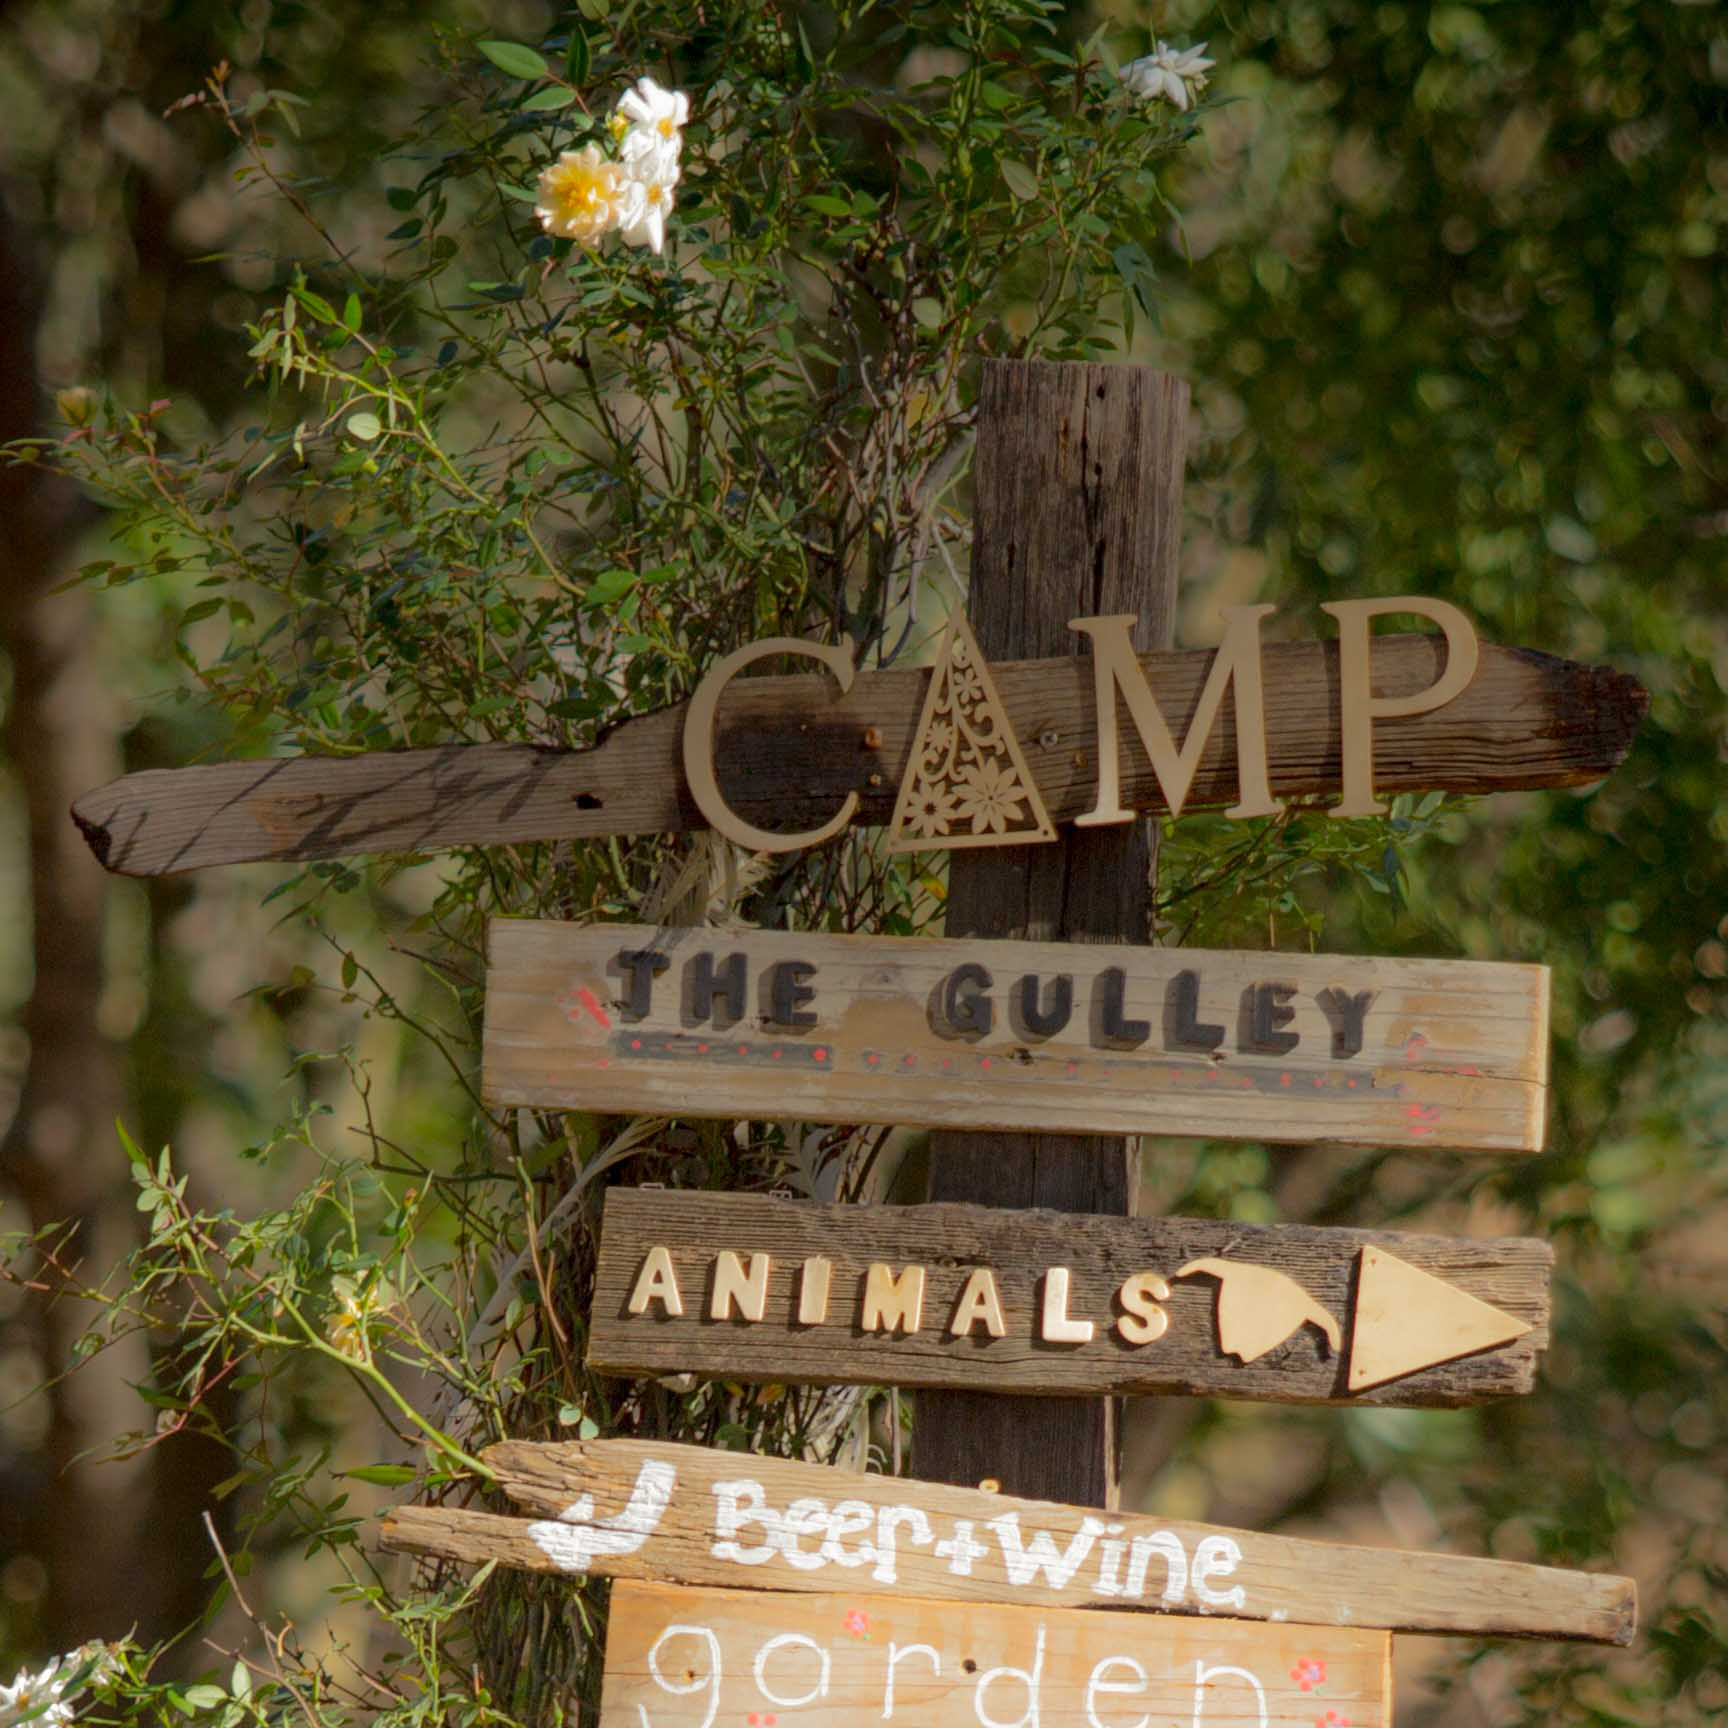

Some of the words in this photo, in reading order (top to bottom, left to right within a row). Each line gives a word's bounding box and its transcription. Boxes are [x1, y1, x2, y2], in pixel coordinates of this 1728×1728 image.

[683, 595, 1479, 853] CAMP
[607, 950, 820, 1036] THE
[926, 962, 1381, 1060] GULLEY
[627, 1246, 1171, 1346] ANIMALS
